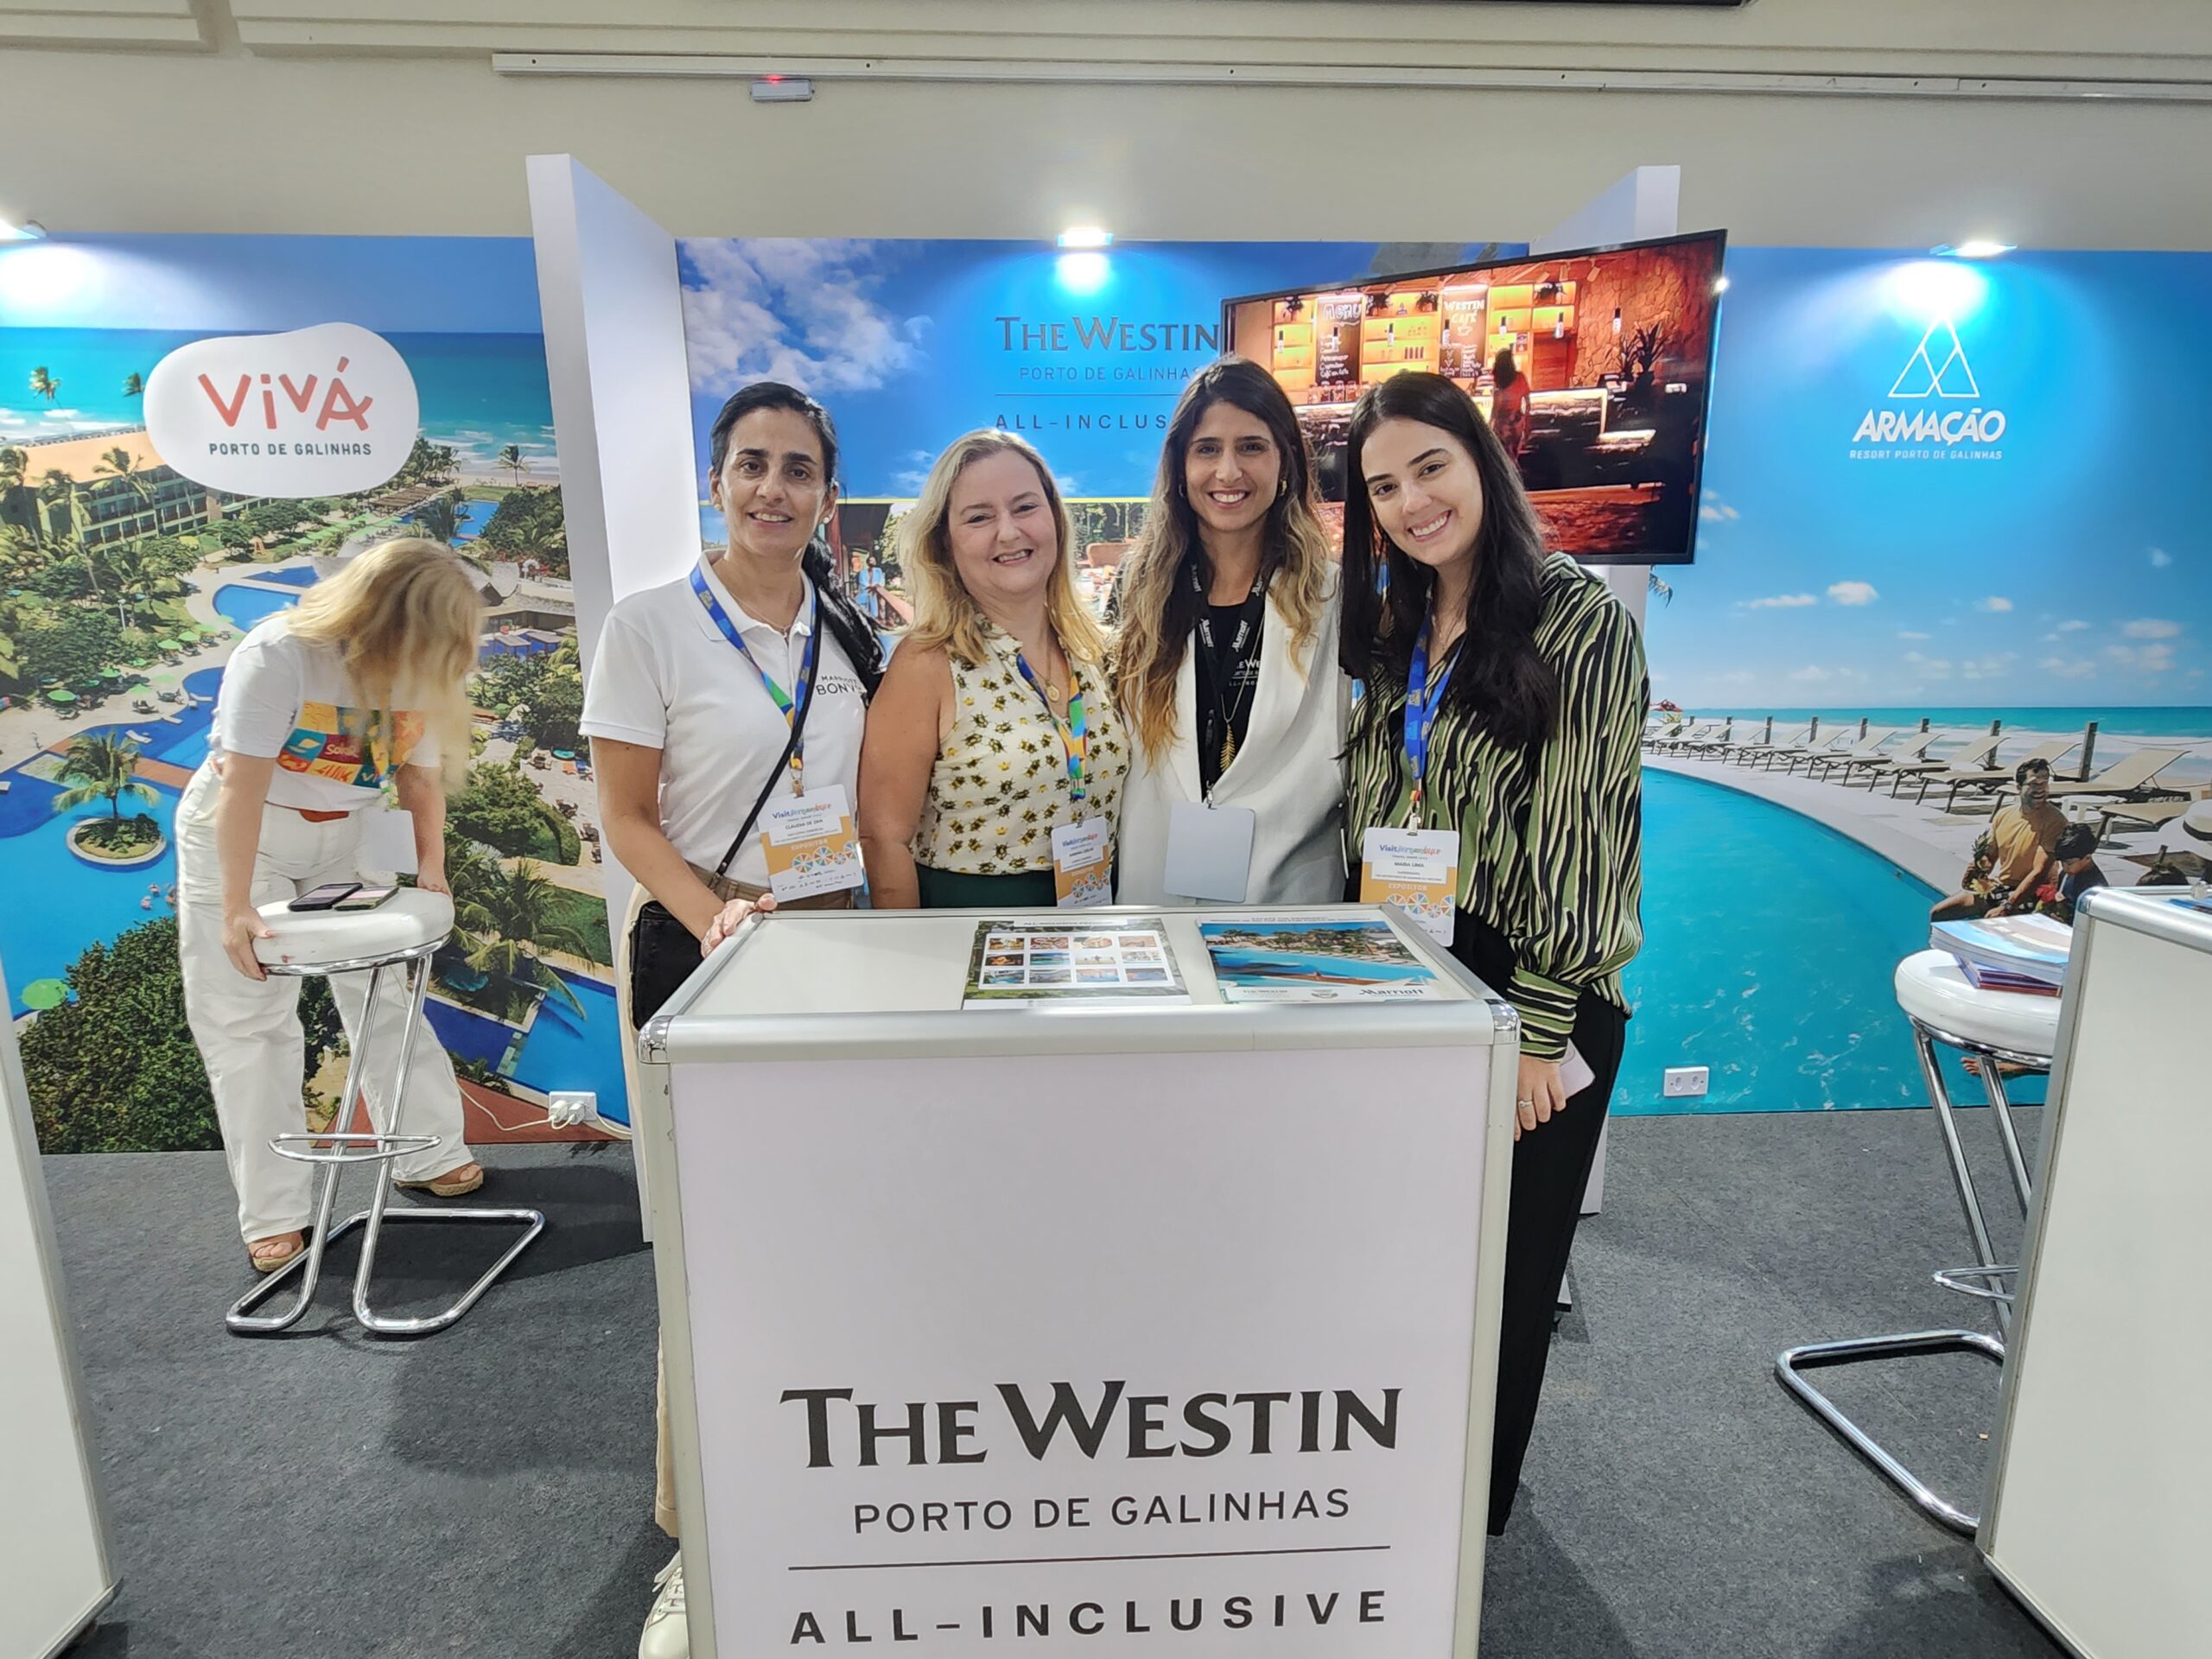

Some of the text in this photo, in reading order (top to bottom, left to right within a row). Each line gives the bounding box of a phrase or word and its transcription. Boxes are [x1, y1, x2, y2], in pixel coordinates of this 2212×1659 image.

[1072, 316, 1219, 351] WESTIN
[1020, 366, 1077, 380] PORTO
[1085, 366, 1106, 380] DE
[1852, 407, 2006, 446] ARMAÇÃO
[209, 443, 372, 455] PORTO DE GALINHAS
[1849, 449, 2003, 460] RESORT PORTO DE GALINHAS
[779, 1379, 1403, 1469] THE WESTIN
[854, 1487, 1351, 1535] PORTO DE GALINHAS
